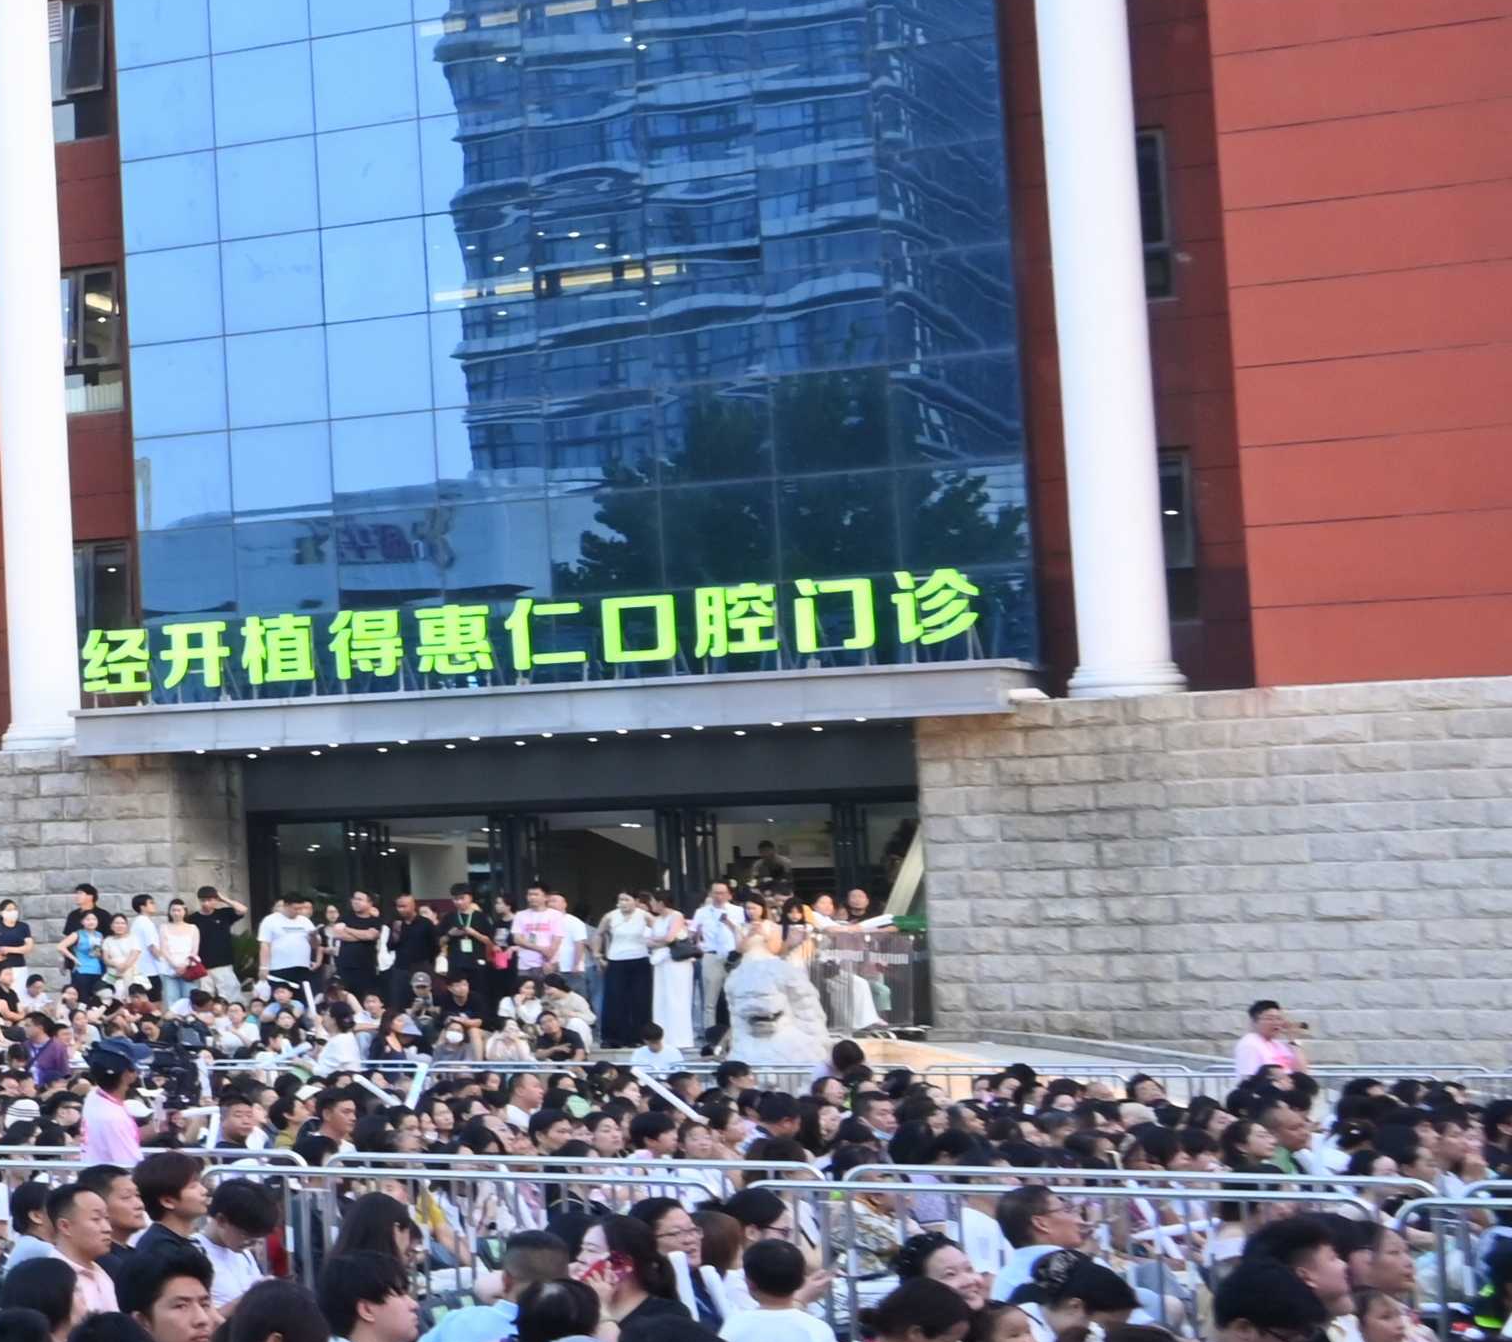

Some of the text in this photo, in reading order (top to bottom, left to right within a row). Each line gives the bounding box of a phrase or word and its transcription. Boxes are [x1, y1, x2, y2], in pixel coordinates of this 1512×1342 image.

[82, 568, 981, 694] 经开植得惠仁口腔门诊
